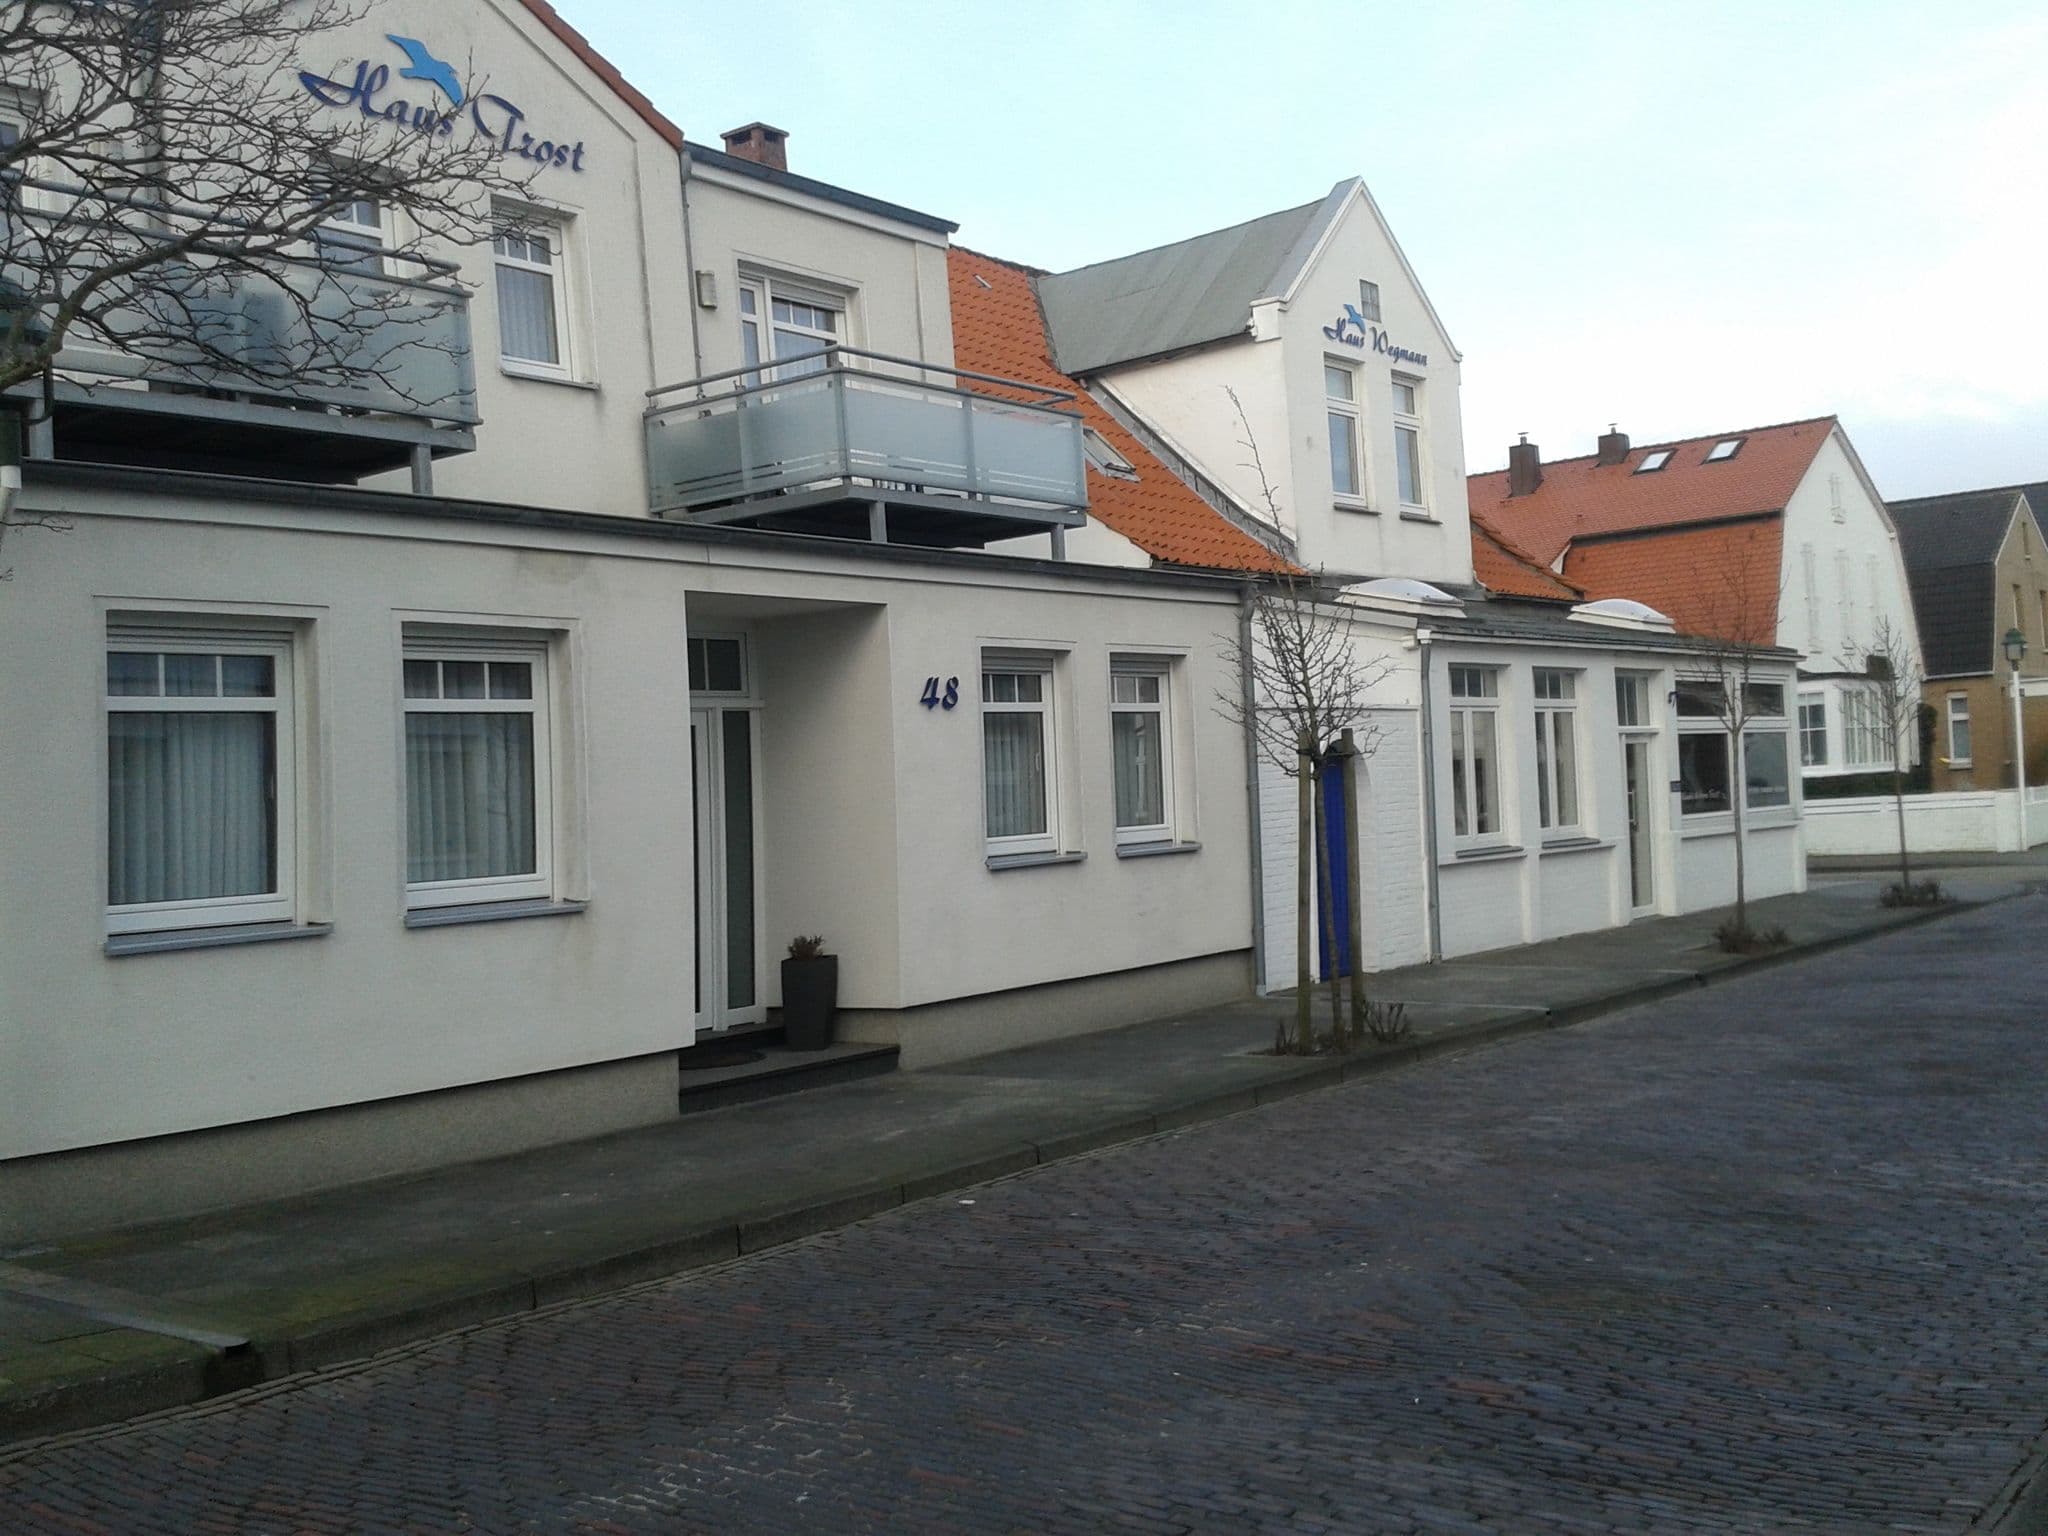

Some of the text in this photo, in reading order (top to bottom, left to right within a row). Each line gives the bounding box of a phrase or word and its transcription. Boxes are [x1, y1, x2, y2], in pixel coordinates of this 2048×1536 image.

[299, 59, 584, 172] Haus Trost
[1323, 317, 1428, 366] Haus Wegmann
[919, 676, 959, 711] 48
